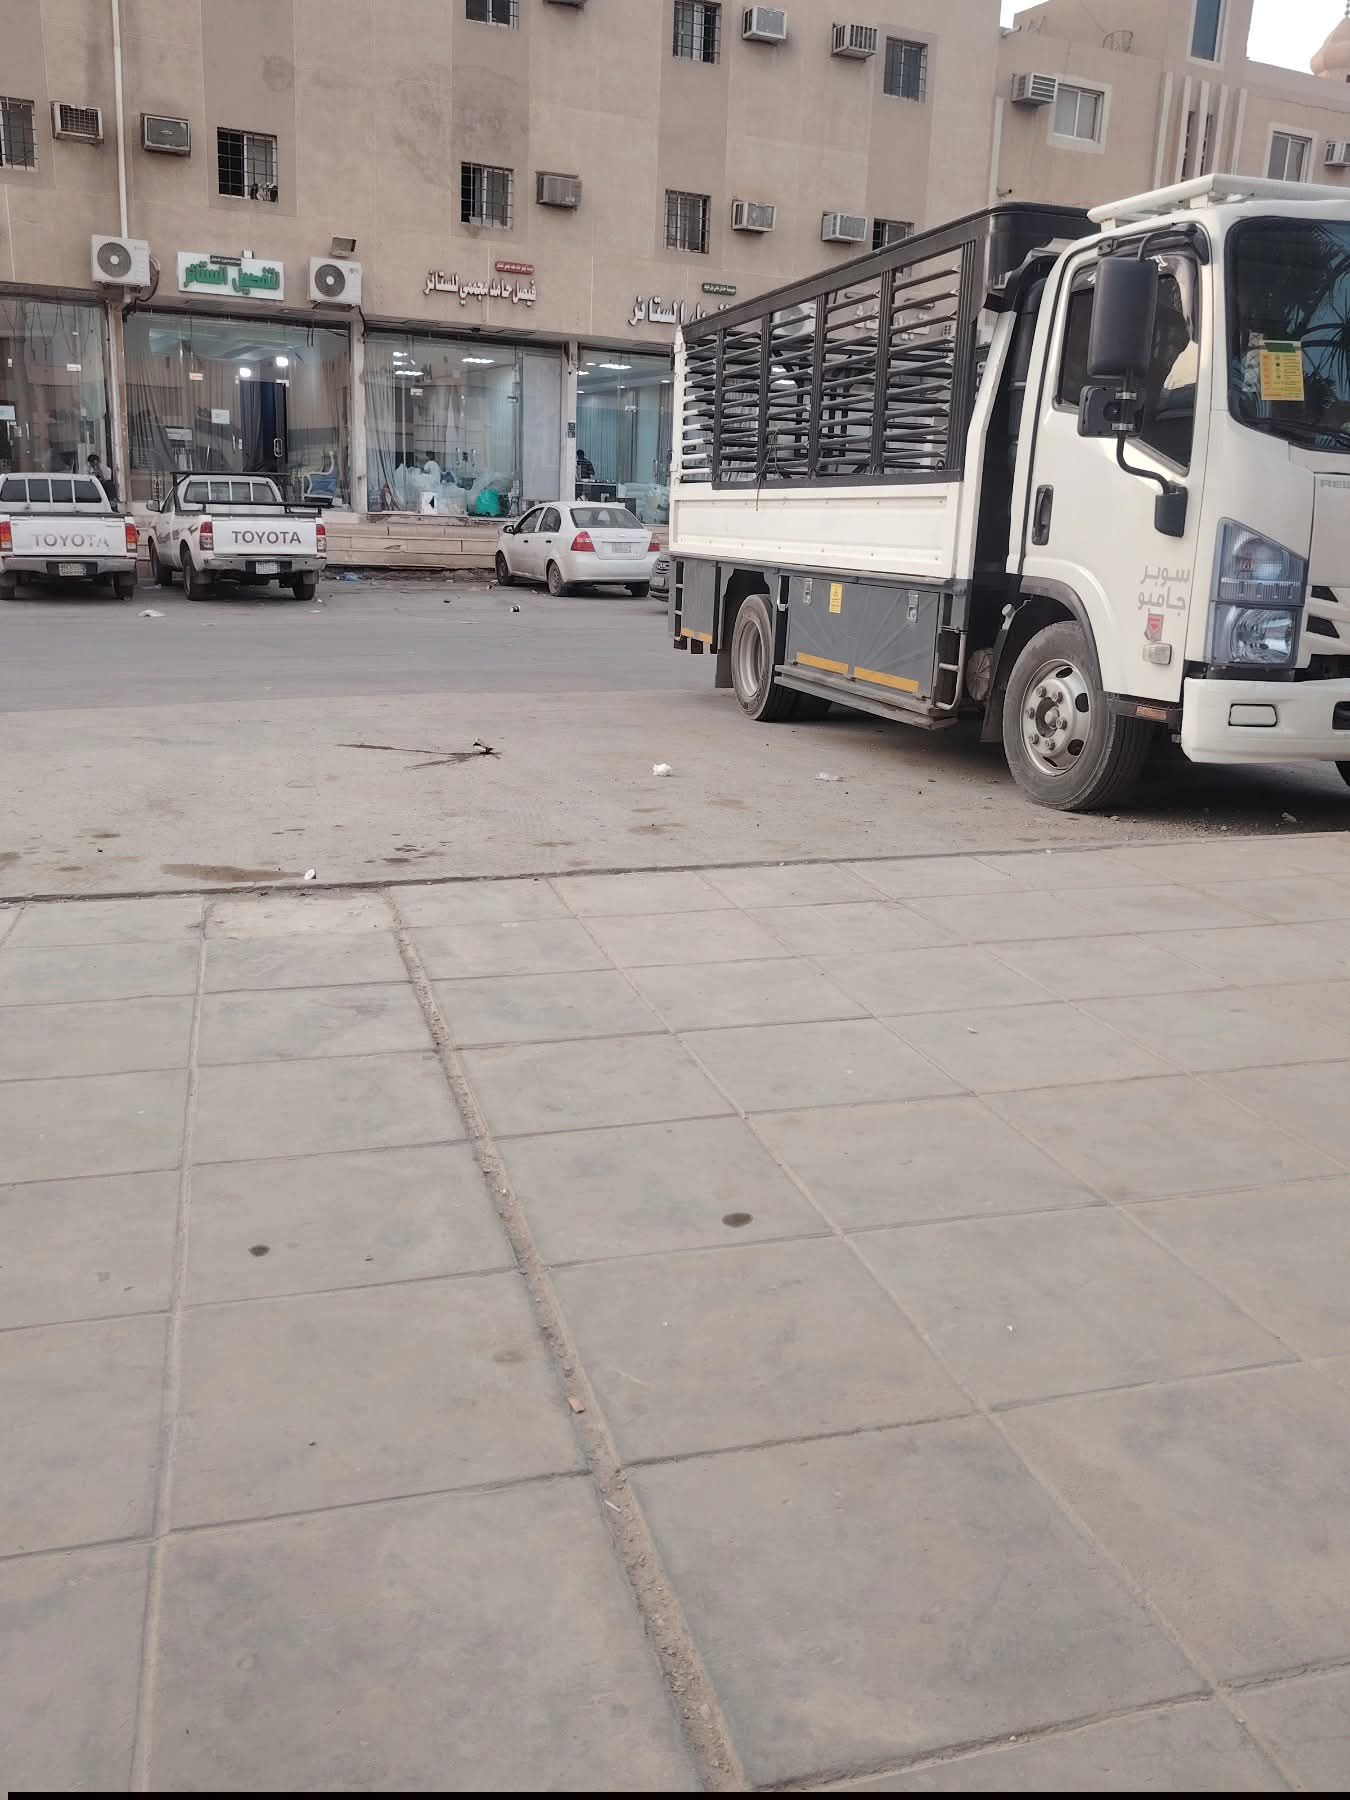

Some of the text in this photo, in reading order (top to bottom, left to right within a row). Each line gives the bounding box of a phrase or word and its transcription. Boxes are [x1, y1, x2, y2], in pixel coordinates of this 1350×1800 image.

[423, 271, 459, 295] للستائر
[512, 279, 537, 306] فيصل
[32, 533, 110, 548] TOYOTA
[231, 530, 302, 545] TOYOTA
[1140, 565, 1191, 587] سوبر
